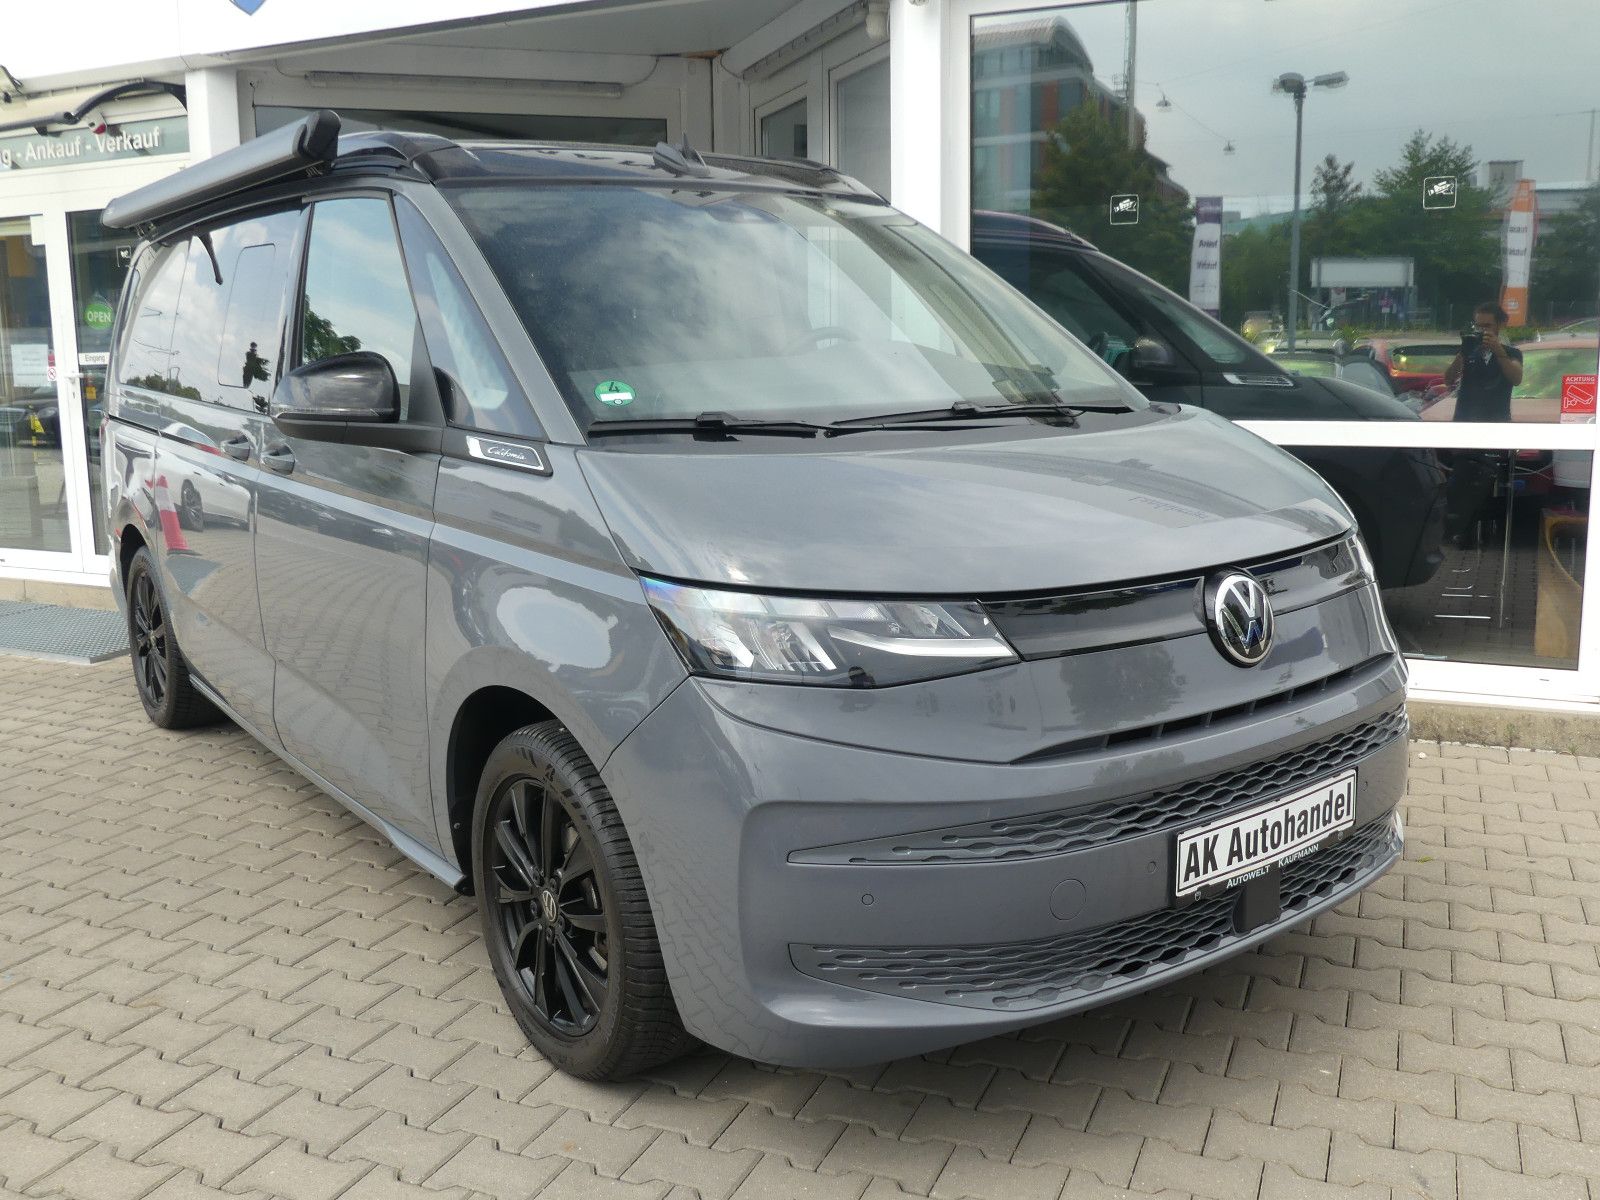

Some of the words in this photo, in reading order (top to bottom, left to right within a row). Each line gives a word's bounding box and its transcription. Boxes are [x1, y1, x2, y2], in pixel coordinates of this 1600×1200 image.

[25, 137, 81, 161] Ankauf
[95, 126, 160, 153] Verkauf
[87, 310, 112, 323] OPEN
[84, 354, 106, 363] Eingang
[608, 381, 620, 393] 4
[1183, 834, 1219, 883] AK
[1226, 781, 1352, 867] Autohandel
[1226, 865, 1270, 889] AUTOWELT
[1278, 843, 1319, 868] KAUFMANN
